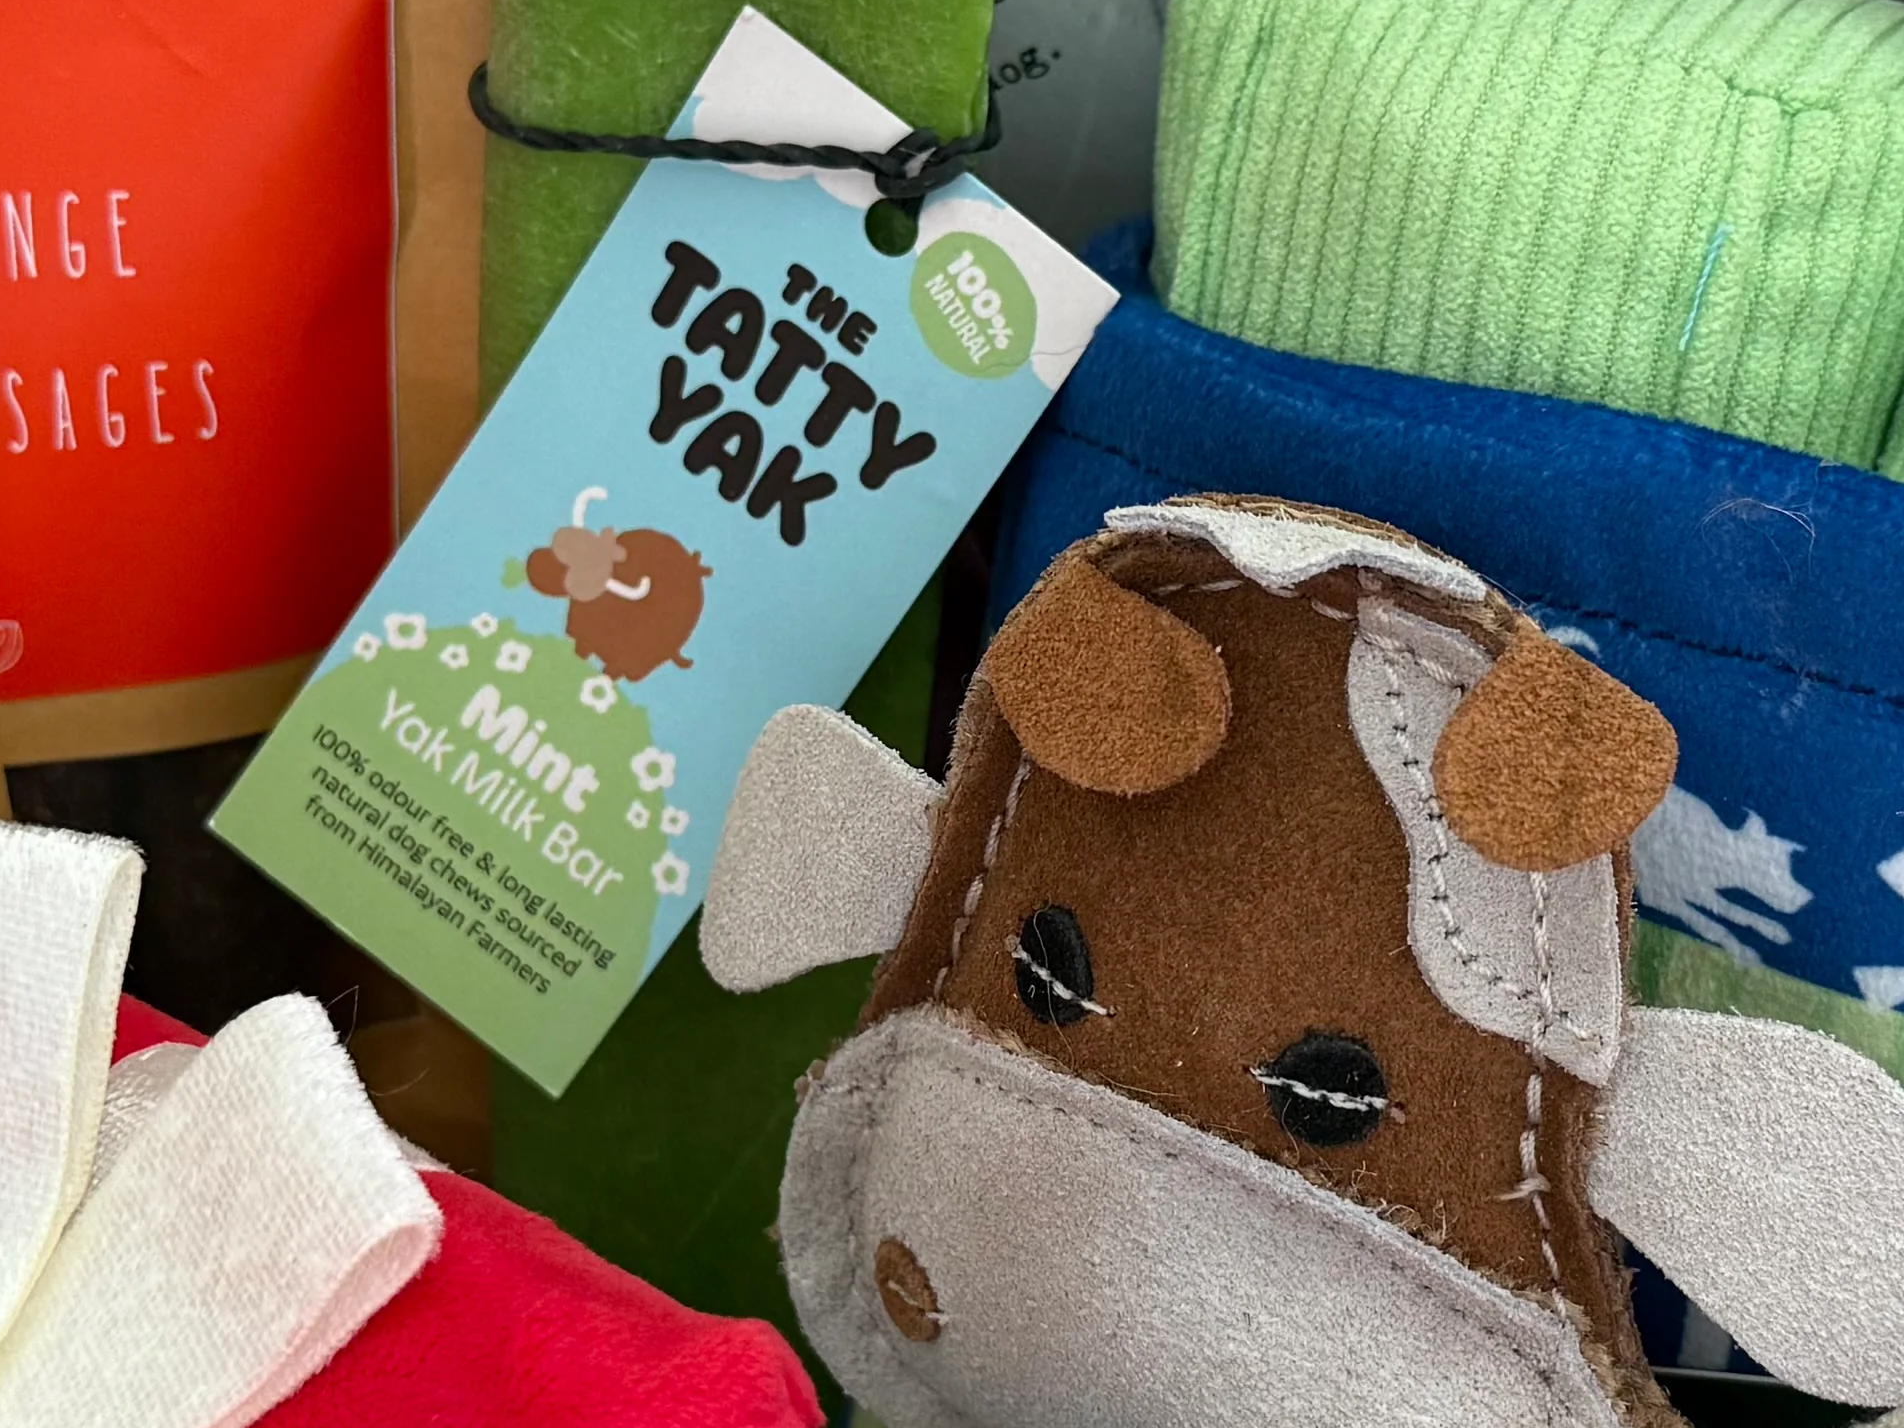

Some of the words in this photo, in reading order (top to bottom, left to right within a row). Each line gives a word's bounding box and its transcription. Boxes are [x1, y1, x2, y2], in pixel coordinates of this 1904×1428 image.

[651, 240, 937, 491] TATTY
[780, 262, 877, 356] THE
[923, 273, 991, 365] NATURAL
[946, 250, 1015, 350] 100%
[648, 355, 838, 547] YAK
[378, 688, 455, 772] Yak
[449, 751, 546, 842] Milk
[542, 820, 624, 895] Bar
[459, 684, 600, 813] Mint
[304, 794, 357, 843] from
[357, 835, 468, 932] Himalayan
[467, 920, 551, 996] Farmers
[311, 724, 370, 777] 100%
[369, 770, 433, 828] odour
[430, 811, 476, 859] free
[475, 847, 496, 875] &
[497, 859, 547, 917] long
[543, 891, 616, 971] lasting
[312, 765, 391, 834] natural
[389, 821, 432, 866] dog
[429, 852, 495, 913] chews
[495, 906, 582, 978] sourced
